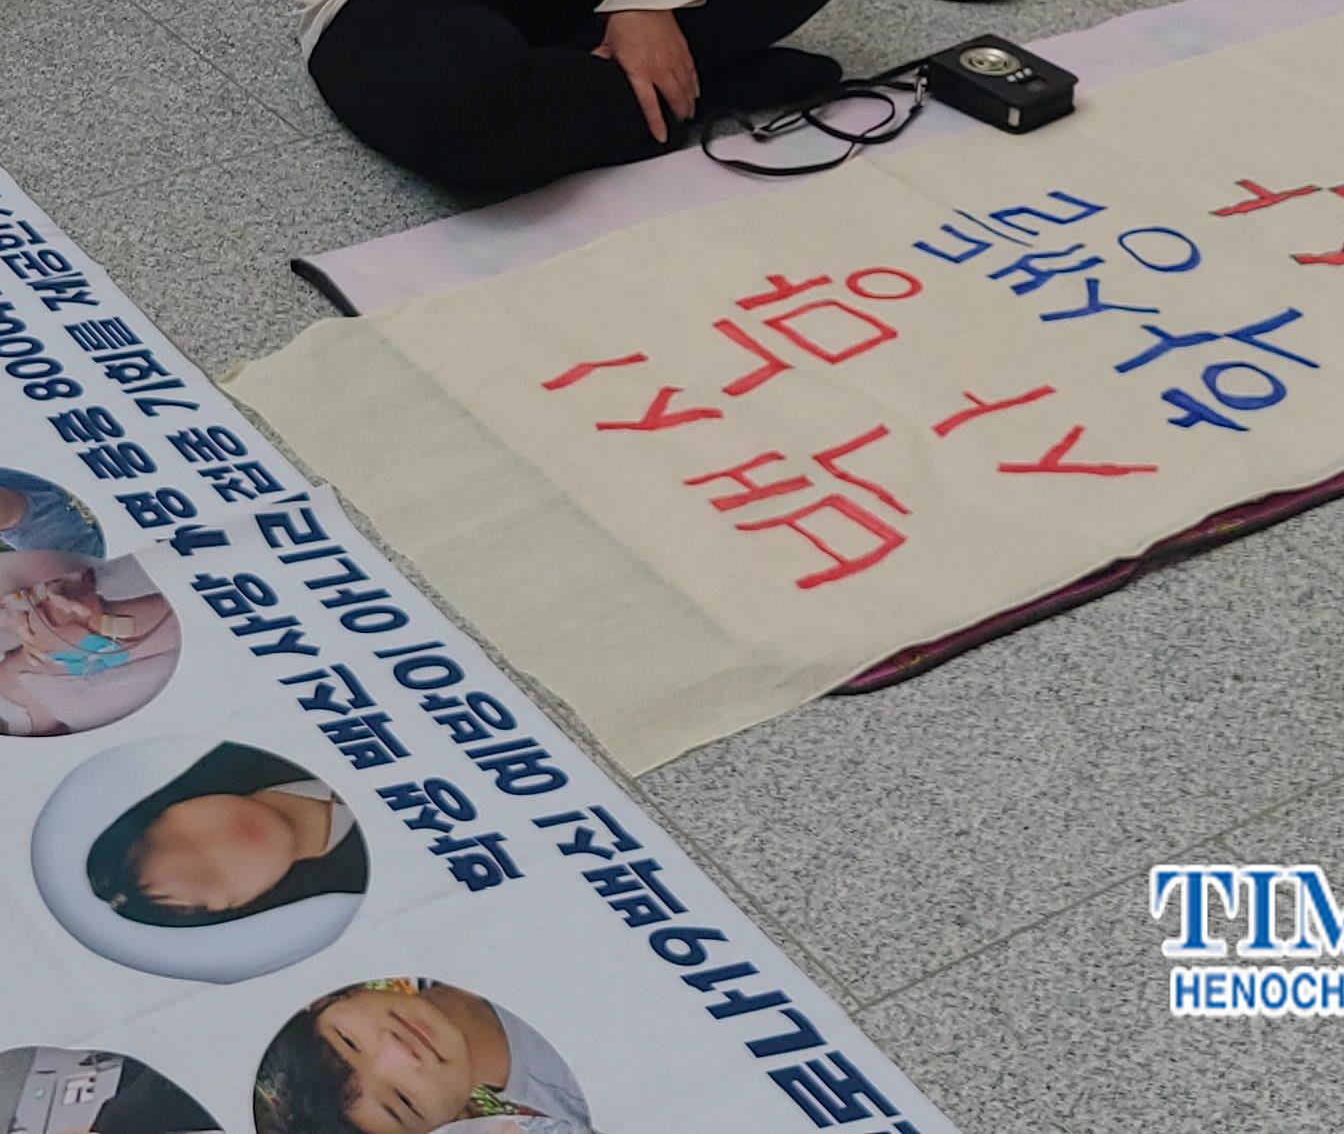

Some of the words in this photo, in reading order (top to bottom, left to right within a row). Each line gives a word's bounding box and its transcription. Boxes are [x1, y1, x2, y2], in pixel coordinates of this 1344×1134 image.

[65, 318, 198, 417] 기회를
[167, 426, 284, 502] 접종
[192, 574, 319, 656] 사망
[279, 664, 410, 770] 백신
[375, 642, 568, 795] 예방이
[377, 778, 523, 892] 학생
[532, 804, 920, 1134] 로나19백신
